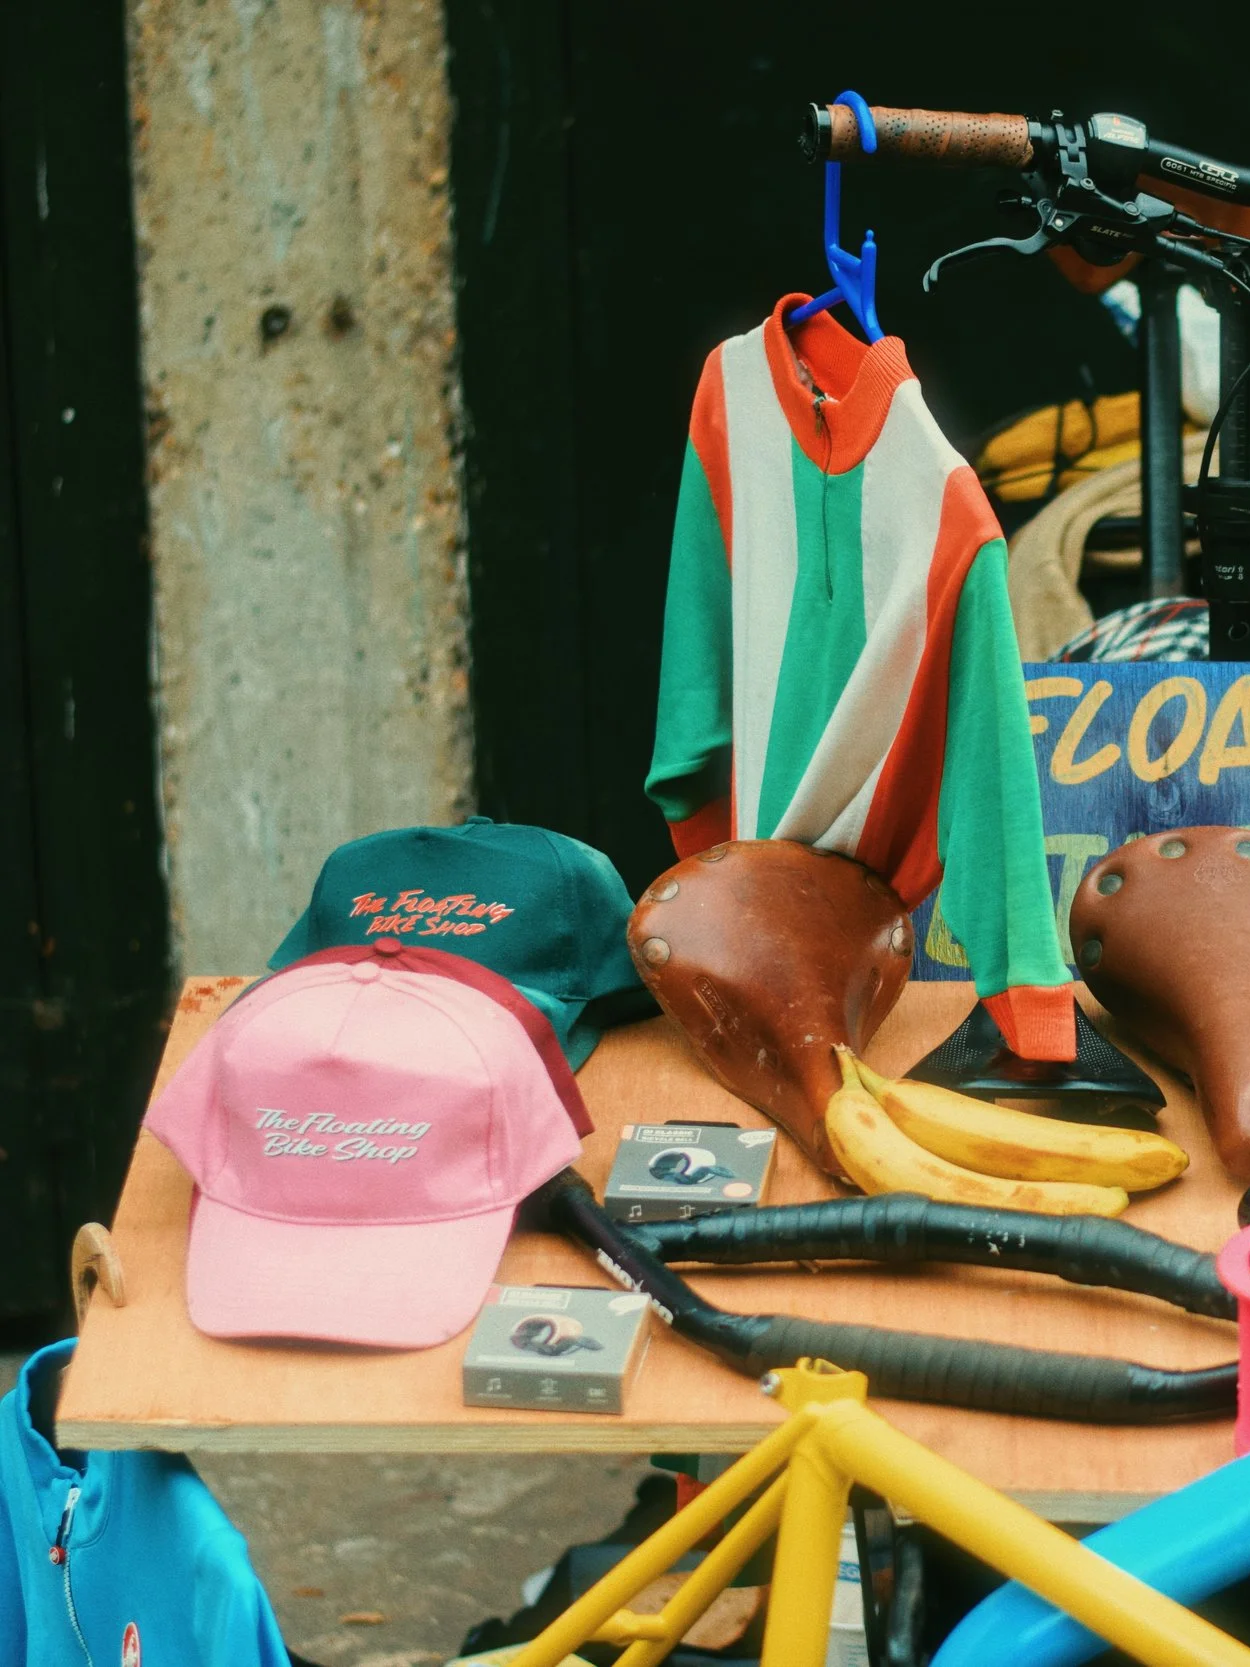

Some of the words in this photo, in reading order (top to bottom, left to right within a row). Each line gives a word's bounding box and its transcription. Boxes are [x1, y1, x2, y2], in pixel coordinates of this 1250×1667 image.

[365, 914, 424, 935] BIKE
[418, 916, 487, 936] SHOP
[256, 1107, 300, 1130] The
[298, 1112, 432, 1140] Floating
[264, 1132, 328, 1157] Bike
[332, 1137, 418, 1164] Shop
